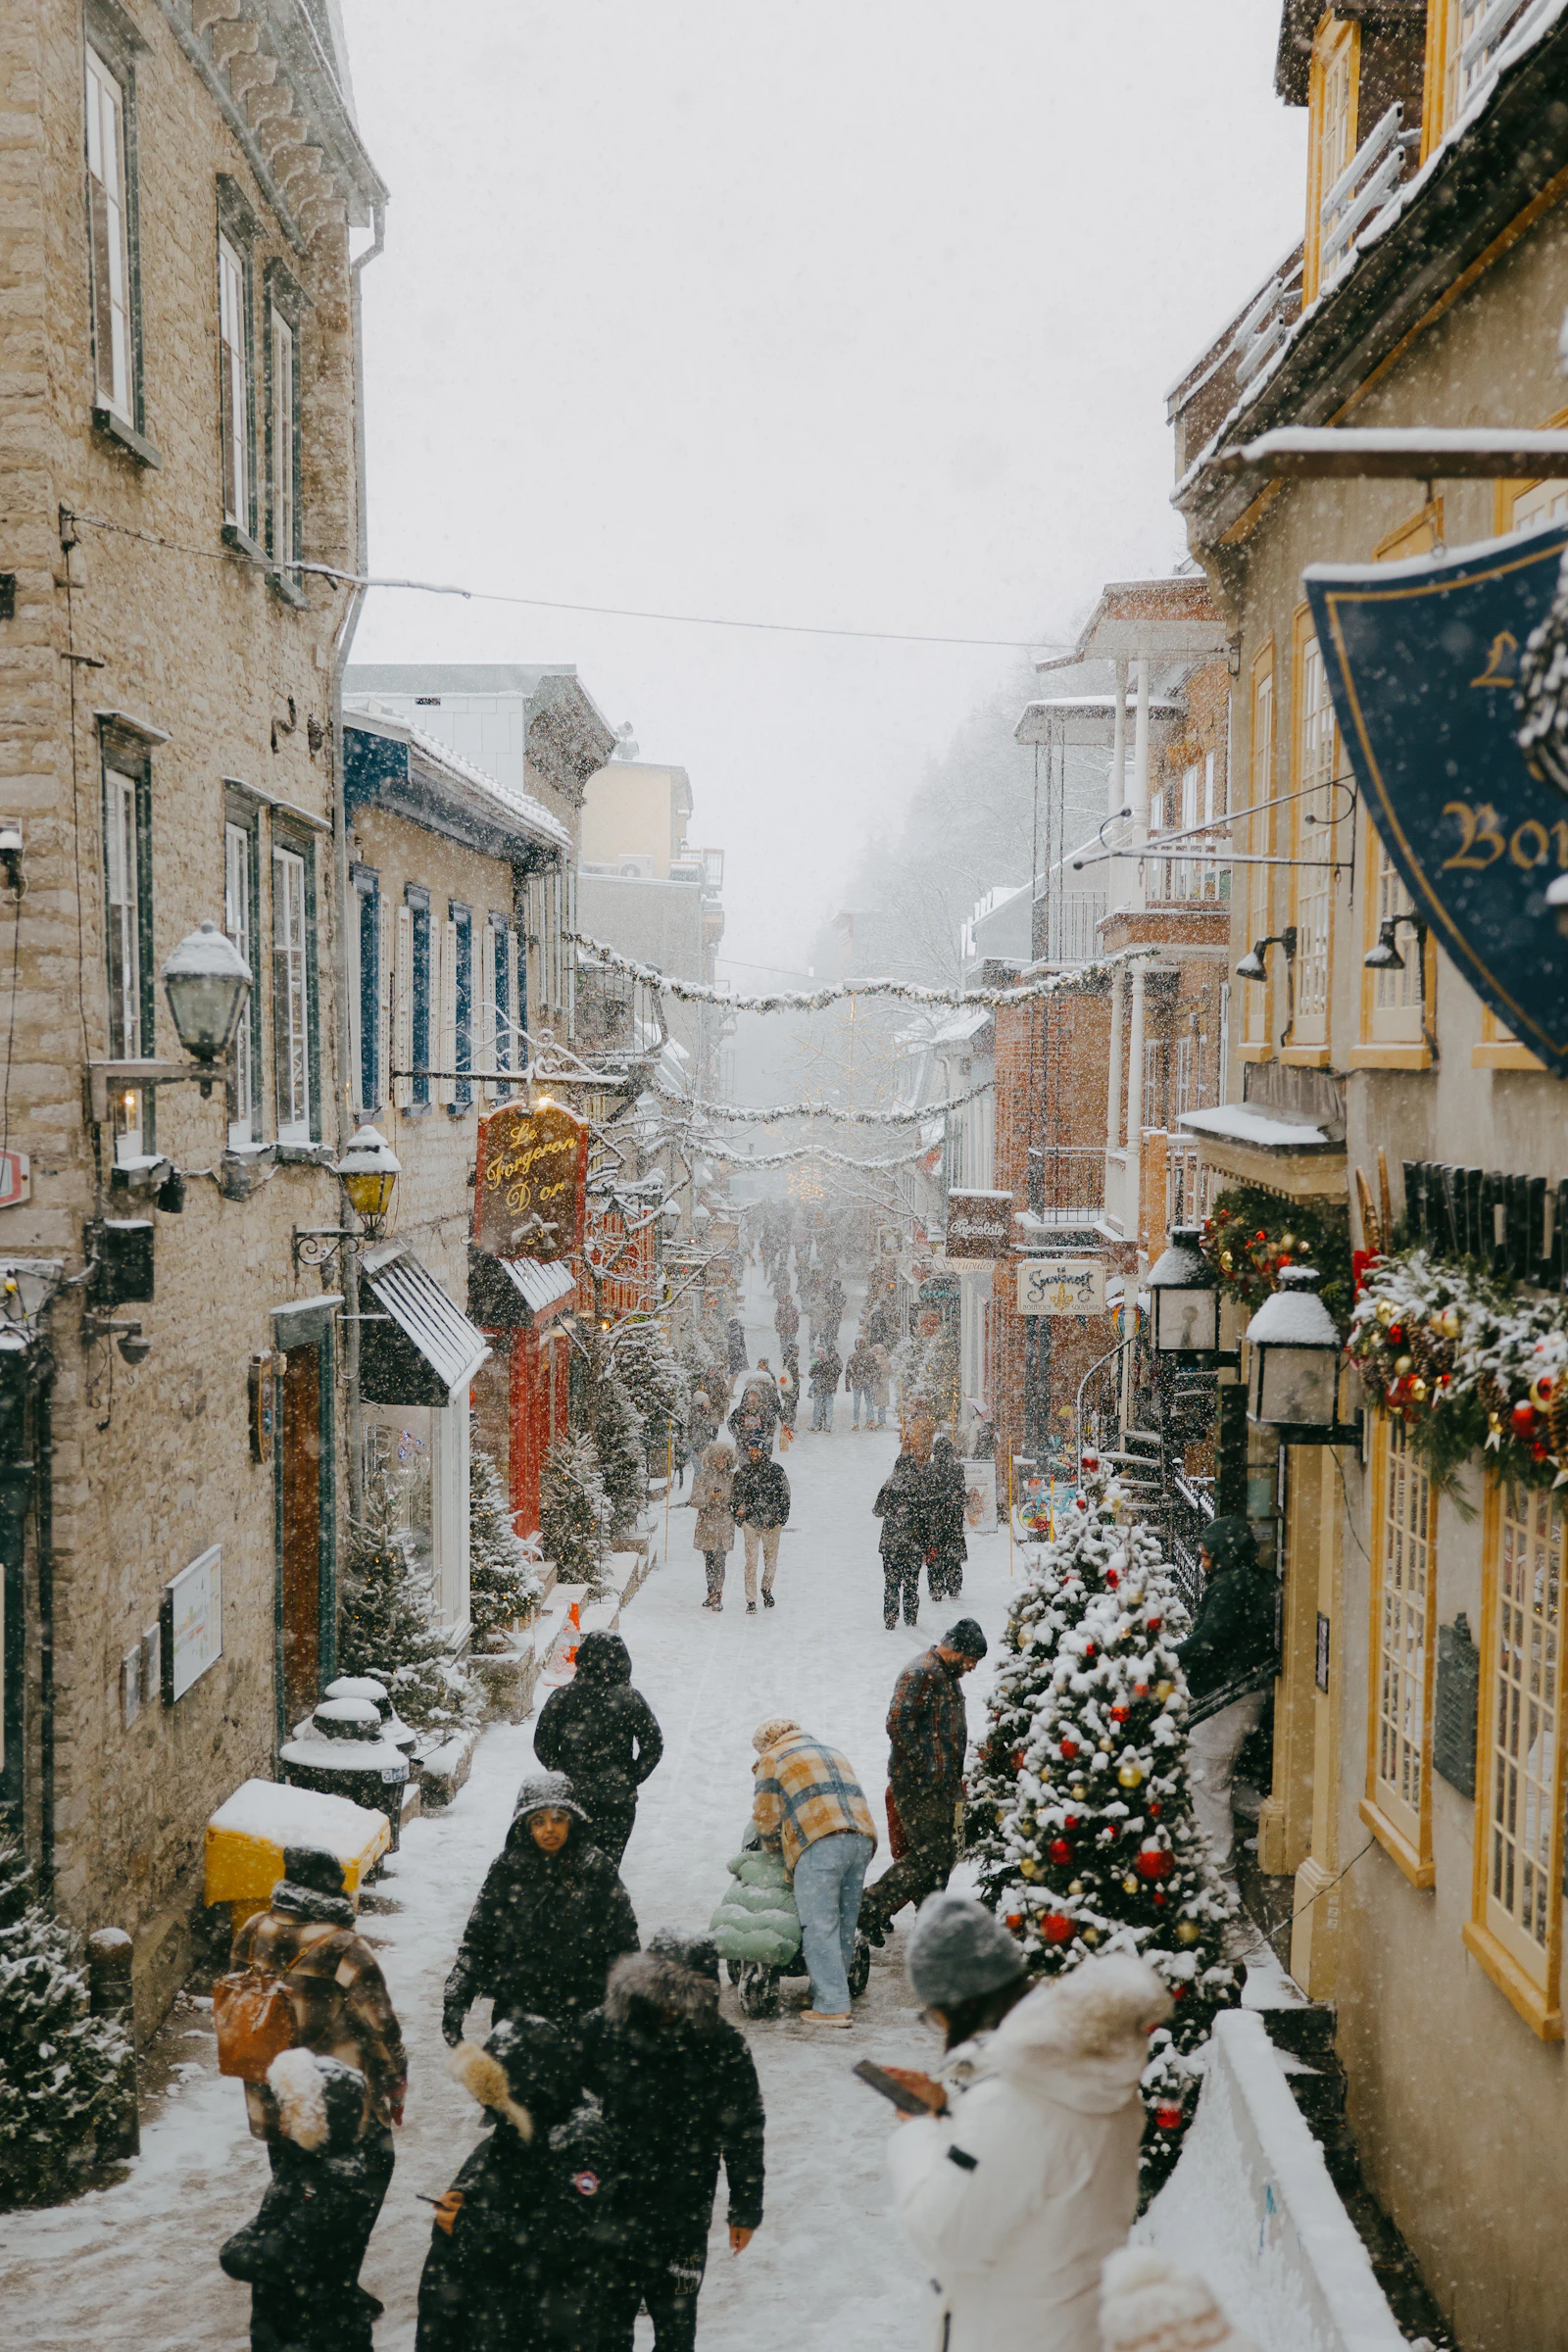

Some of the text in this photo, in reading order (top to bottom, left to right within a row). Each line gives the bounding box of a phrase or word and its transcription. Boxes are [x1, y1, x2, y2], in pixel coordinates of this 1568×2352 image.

[1470, 629, 1518, 688] L
[510, 1122, 537, 1148] Le
[486, 1137, 578, 1191] Forgeron
[506, 1177, 565, 1216] D'or
